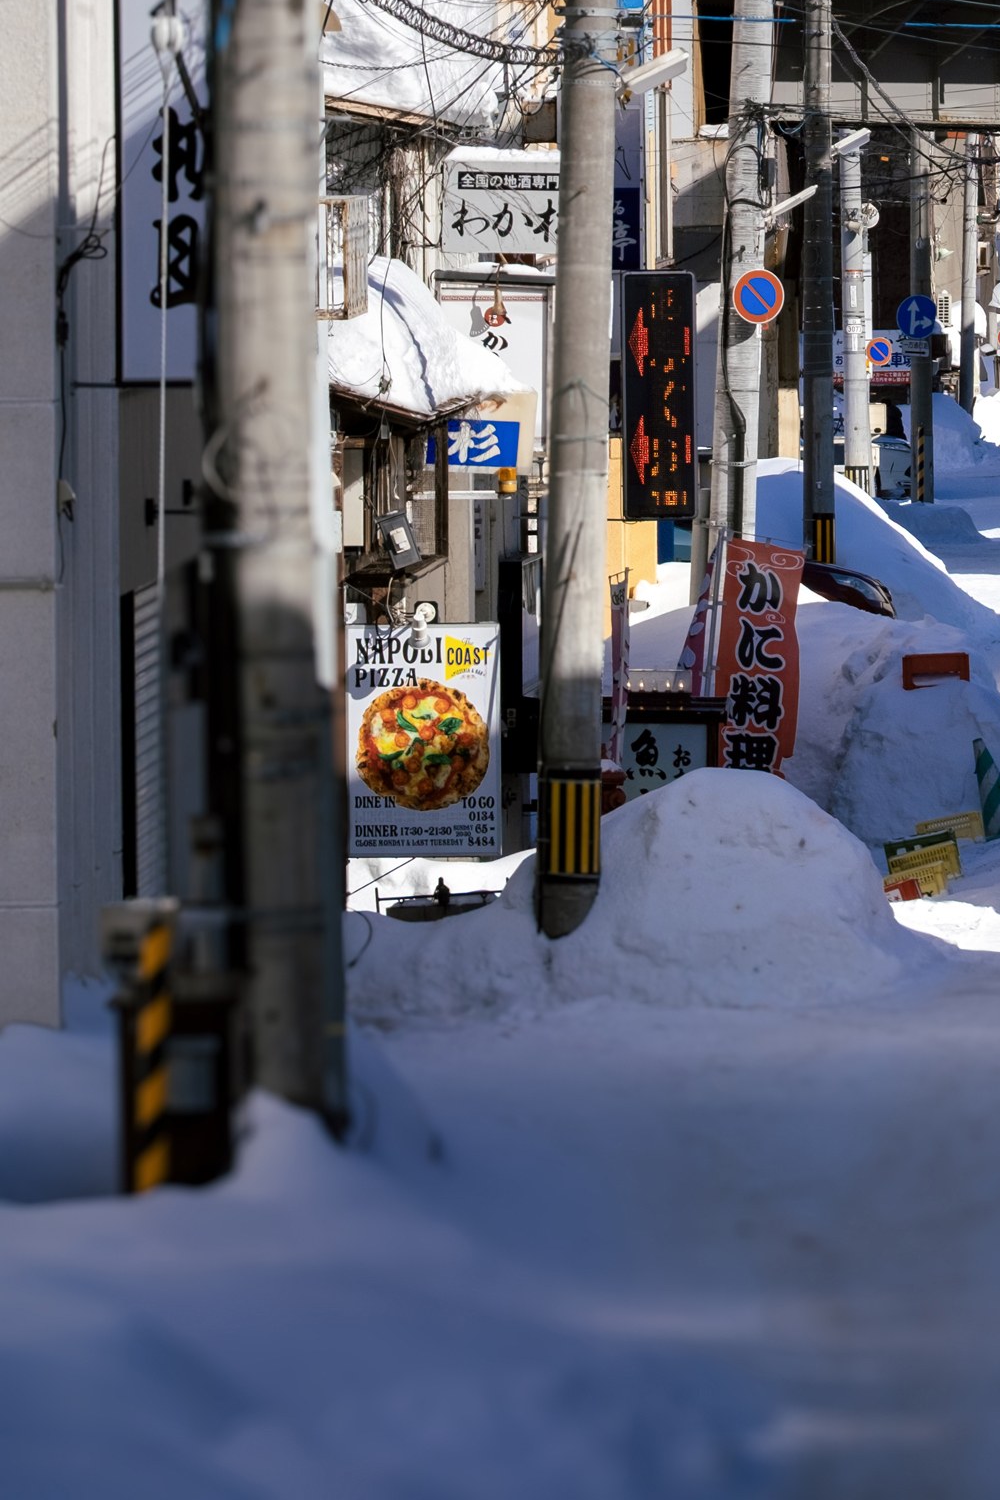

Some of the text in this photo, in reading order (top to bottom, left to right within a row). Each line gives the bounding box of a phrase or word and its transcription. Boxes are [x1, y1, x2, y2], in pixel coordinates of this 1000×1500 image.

[460, 173, 559, 190] 全国の地酒専門
[447, 647, 490, 666] COAST
[723, 562, 786, 773] かに料理
[355, 668, 418, 687] PIZZA
[355, 795, 396, 809] DINE IN
[461, 796, 495, 809] TO GO
[468, 811, 495, 822] 0134
[355, 825, 398, 838] DINNER
[468, 836, 495, 847] 8484
